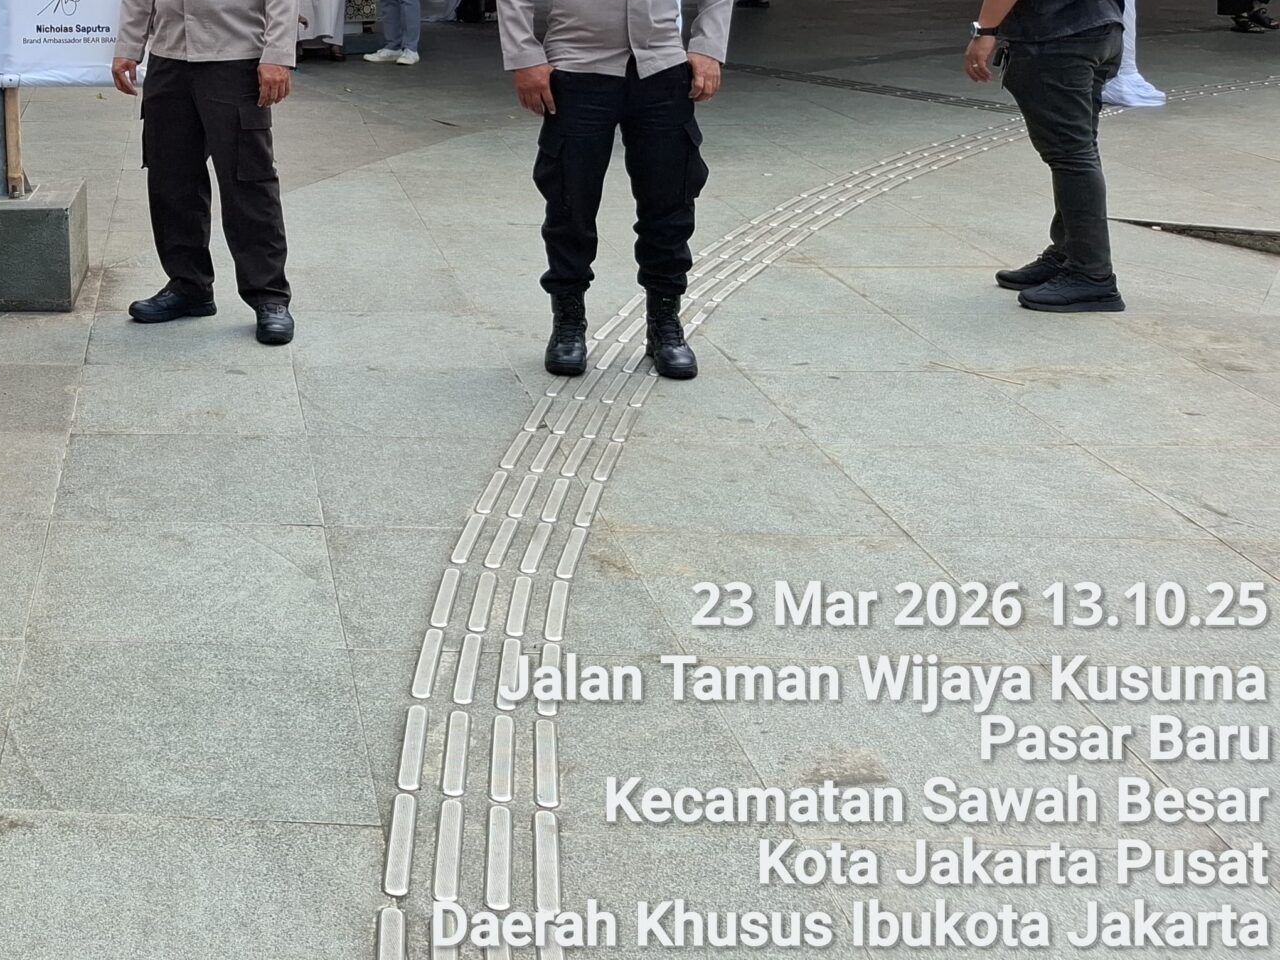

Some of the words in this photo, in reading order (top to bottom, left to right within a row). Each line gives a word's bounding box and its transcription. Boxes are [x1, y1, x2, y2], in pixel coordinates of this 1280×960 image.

[36, 24, 74, 34] Nicholas
[75, 24, 111, 35] Saputra
[42, 36, 81, 44] Ambassador
[82, 36, 100, 44] BEAR
